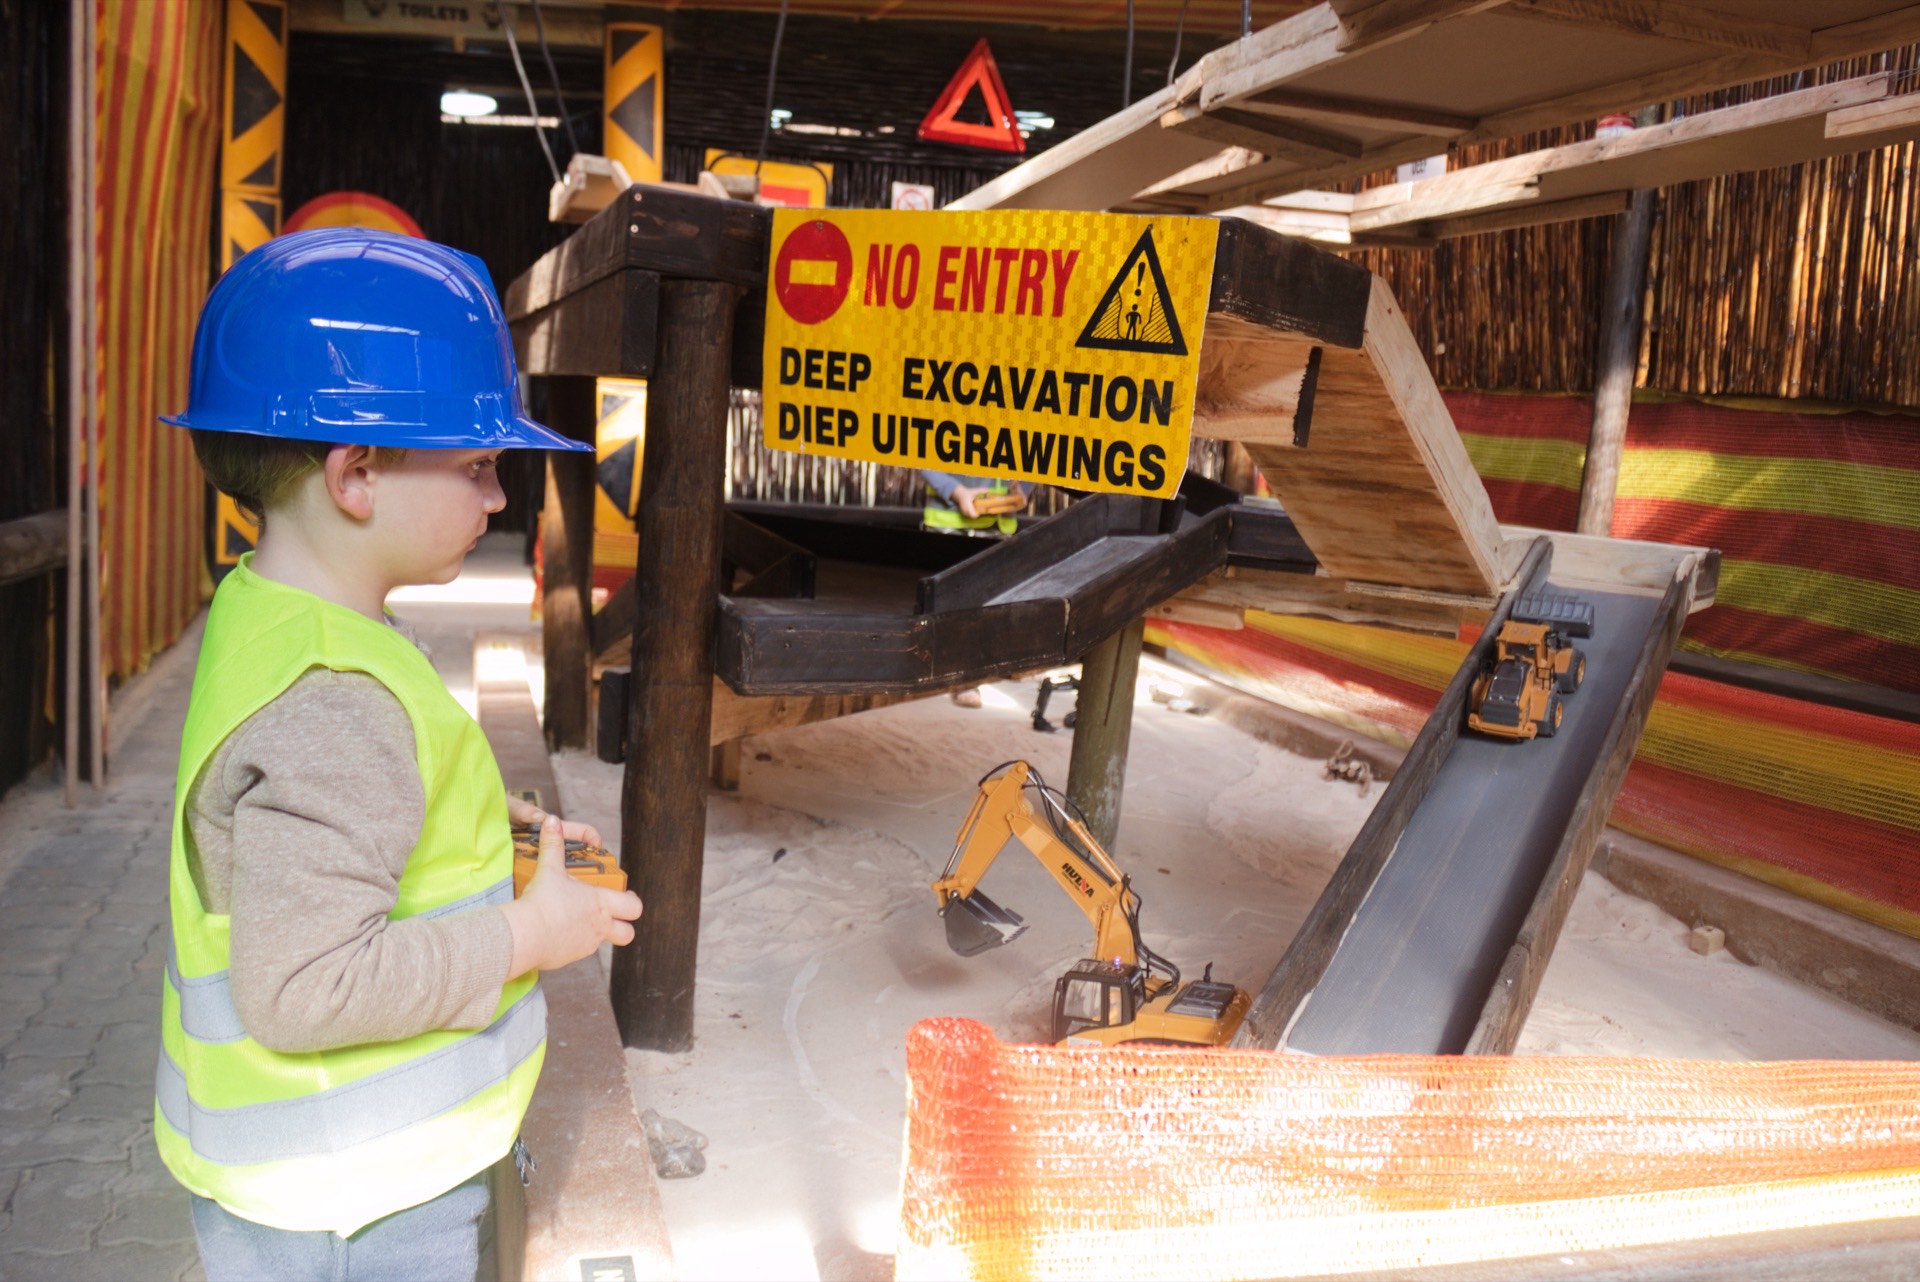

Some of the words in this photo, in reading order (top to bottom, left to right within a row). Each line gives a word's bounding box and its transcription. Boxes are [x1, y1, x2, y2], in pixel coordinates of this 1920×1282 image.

[398, 2, 470, 22] TOILETS
[863, 243, 921, 310] NO
[933, 245, 1080, 318] ENTRY
[779, 347, 872, 393] DEEP
[901, 357, 1175, 427] EXCAVATION
[778, 403, 859, 448] DIEP
[871, 412, 1167, 492] UITGRAWINGS
